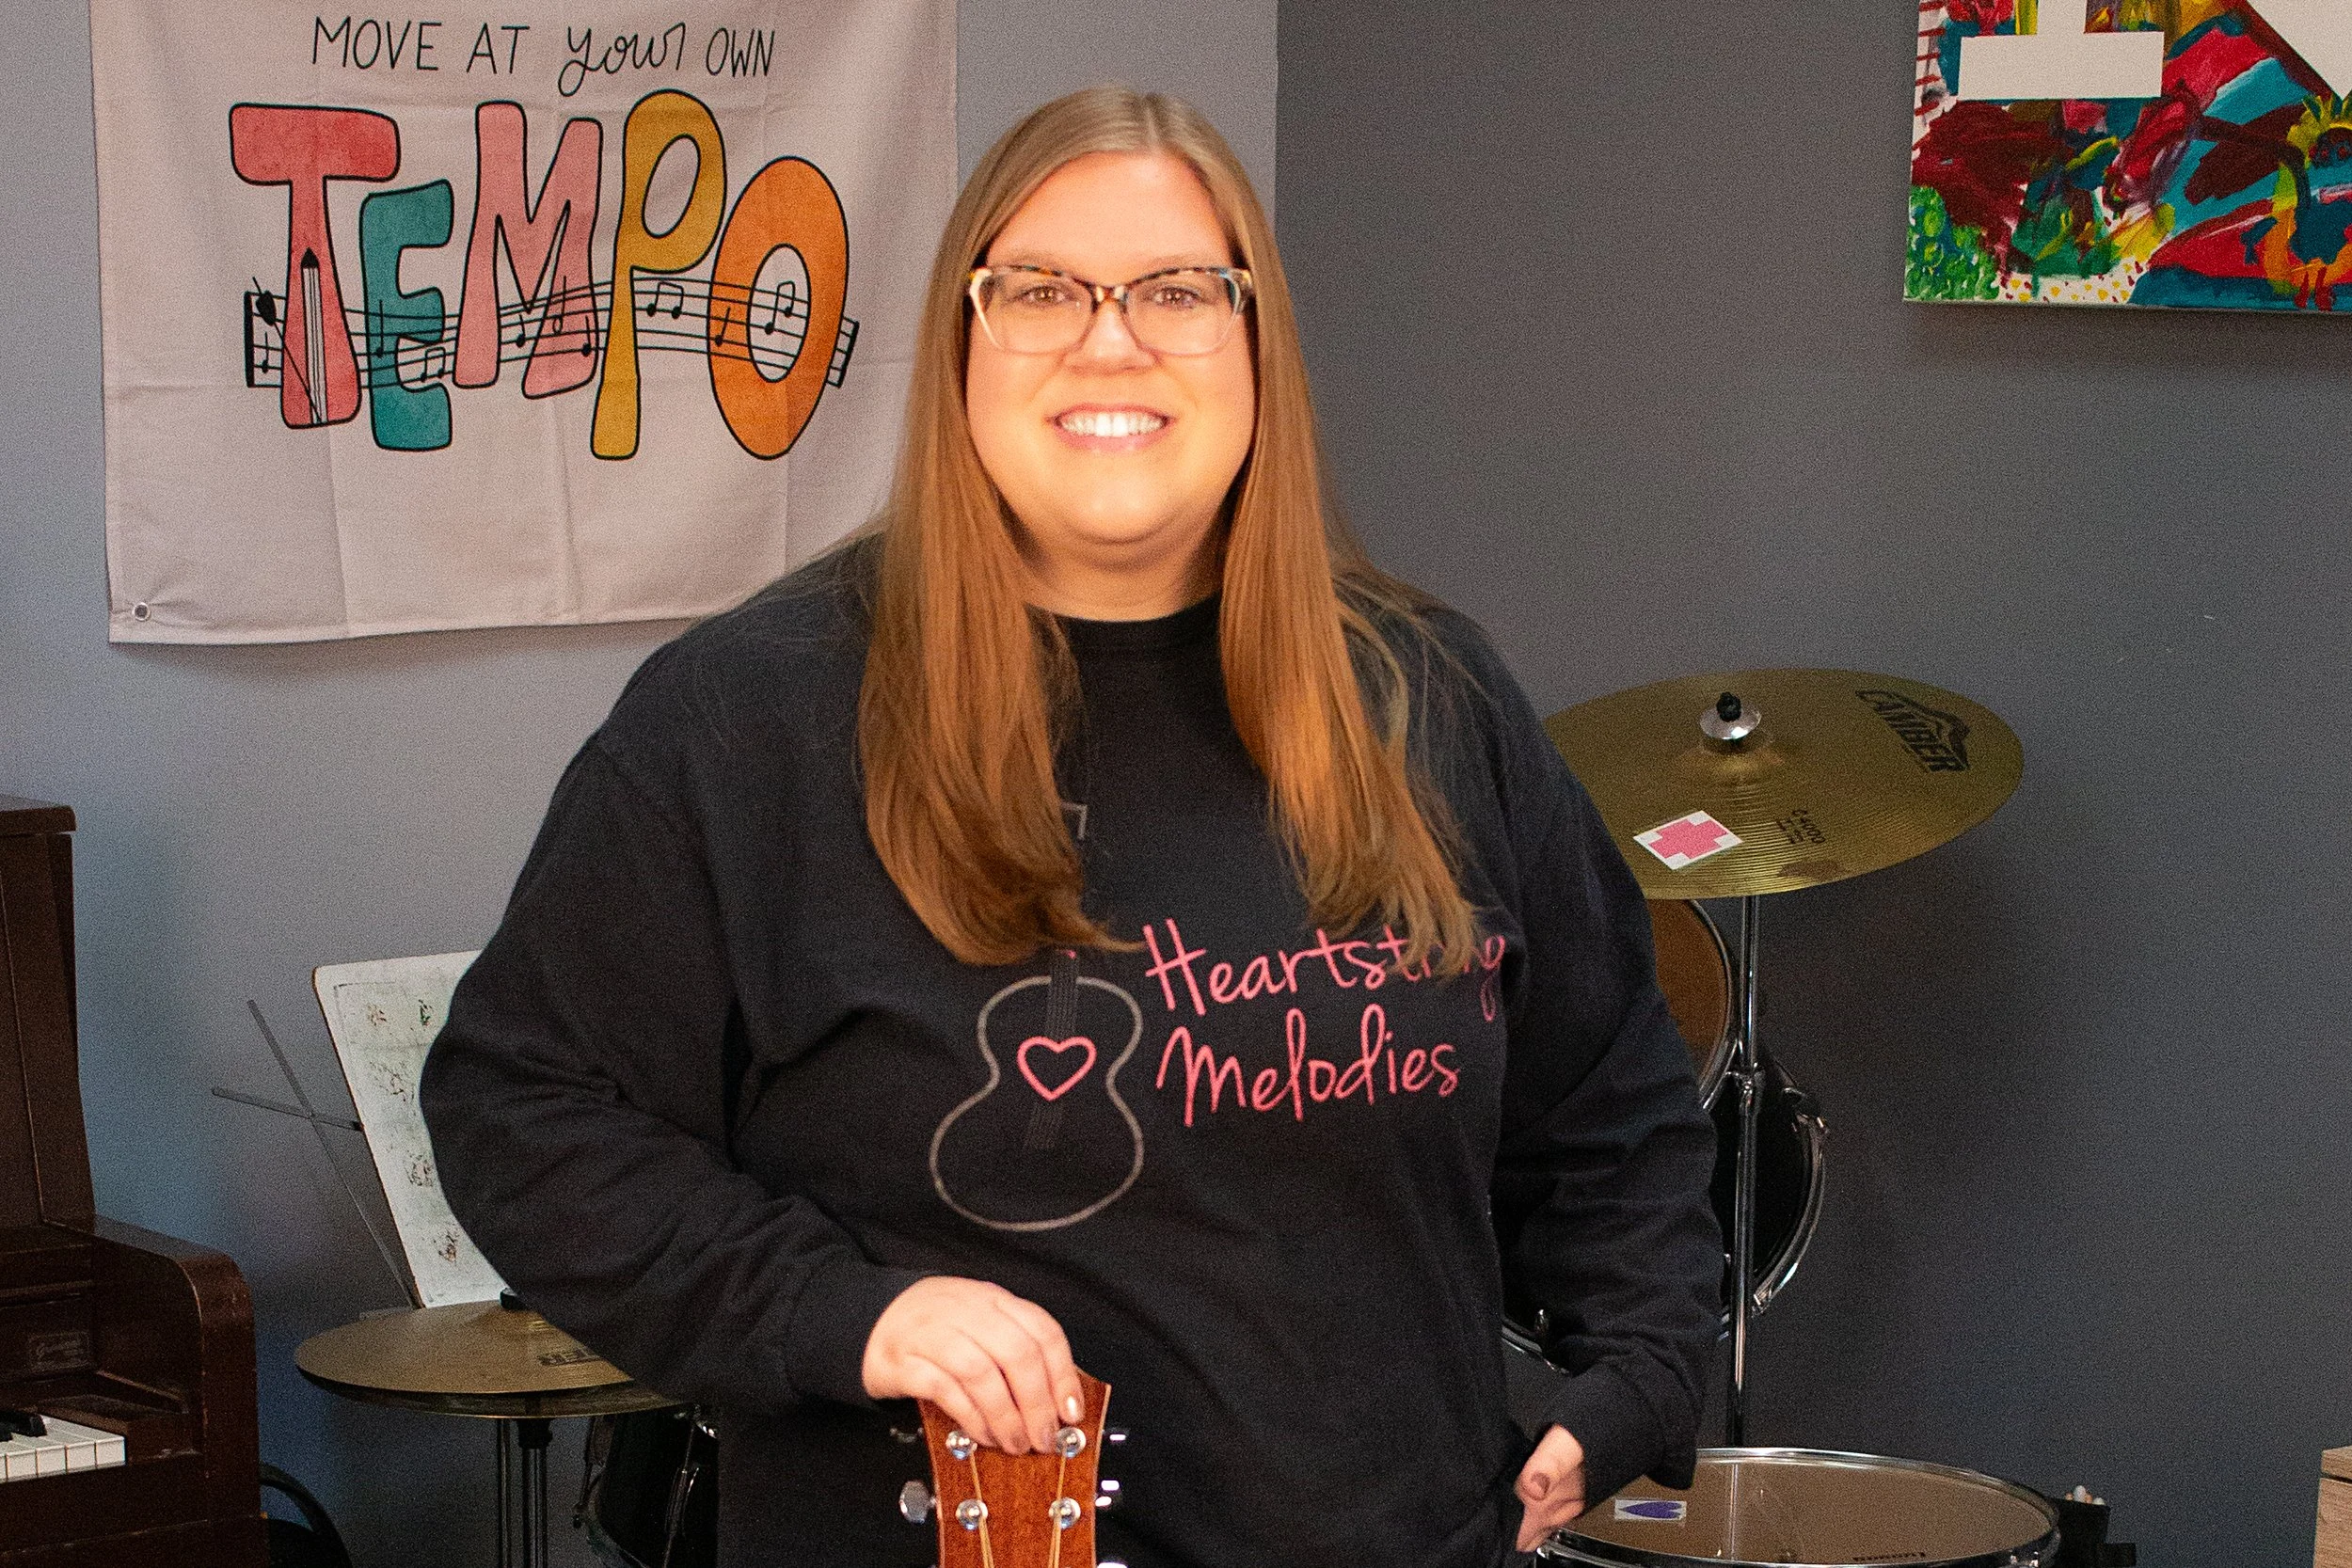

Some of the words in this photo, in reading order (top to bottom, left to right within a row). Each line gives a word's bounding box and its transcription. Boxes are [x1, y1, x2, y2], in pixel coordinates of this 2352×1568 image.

[311, 15, 443, 71] MOVE
[467, 23, 530, 74] AT
[557, 21, 687, 97] your
[704, 27, 775, 78] OWN
[229, 87, 850, 460] TEMPO
[1141, 917, 1506, 1023] Heartstg
[1155, 1003, 1462, 1129] Melodies
